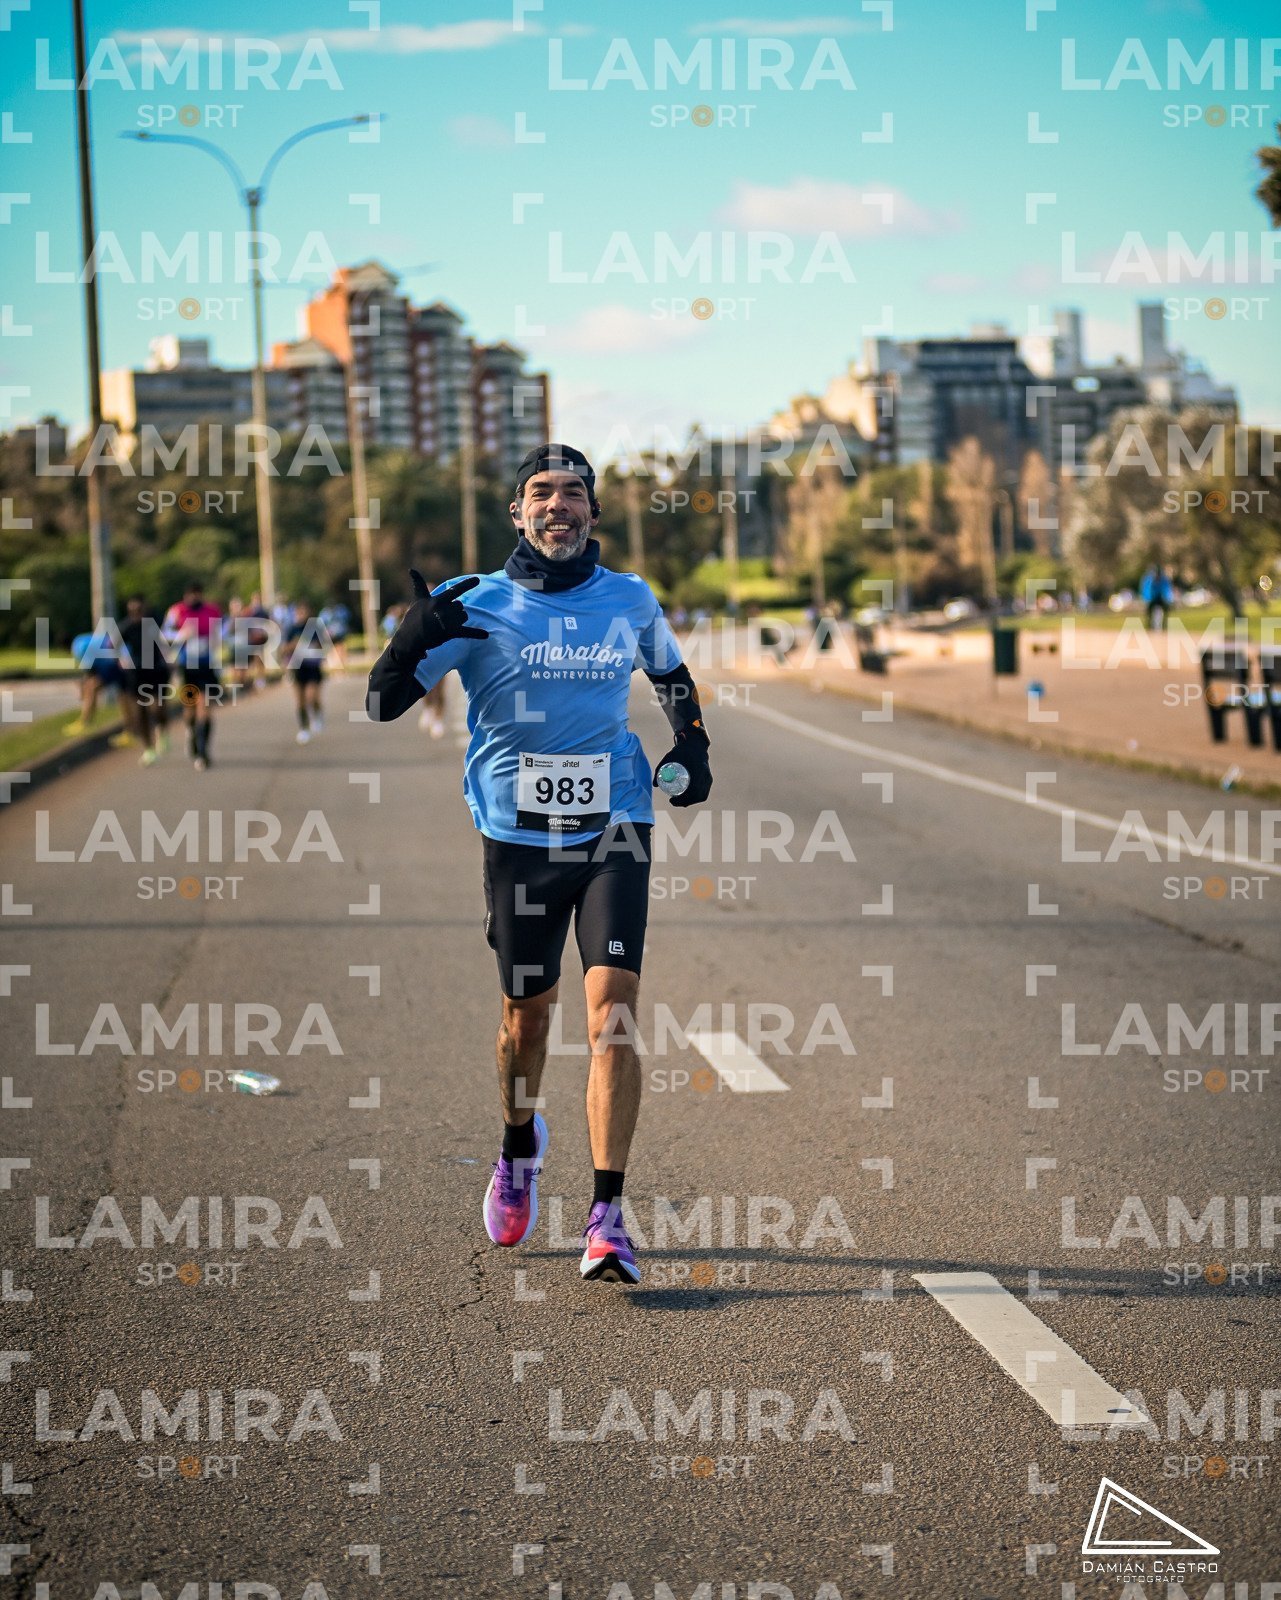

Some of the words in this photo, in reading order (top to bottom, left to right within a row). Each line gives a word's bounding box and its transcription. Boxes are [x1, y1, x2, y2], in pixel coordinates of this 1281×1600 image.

[520, 640, 624, 668] Maratón
[531, 670, 616, 680] MONTEVIDEO
[535, 777, 594, 805] 983
